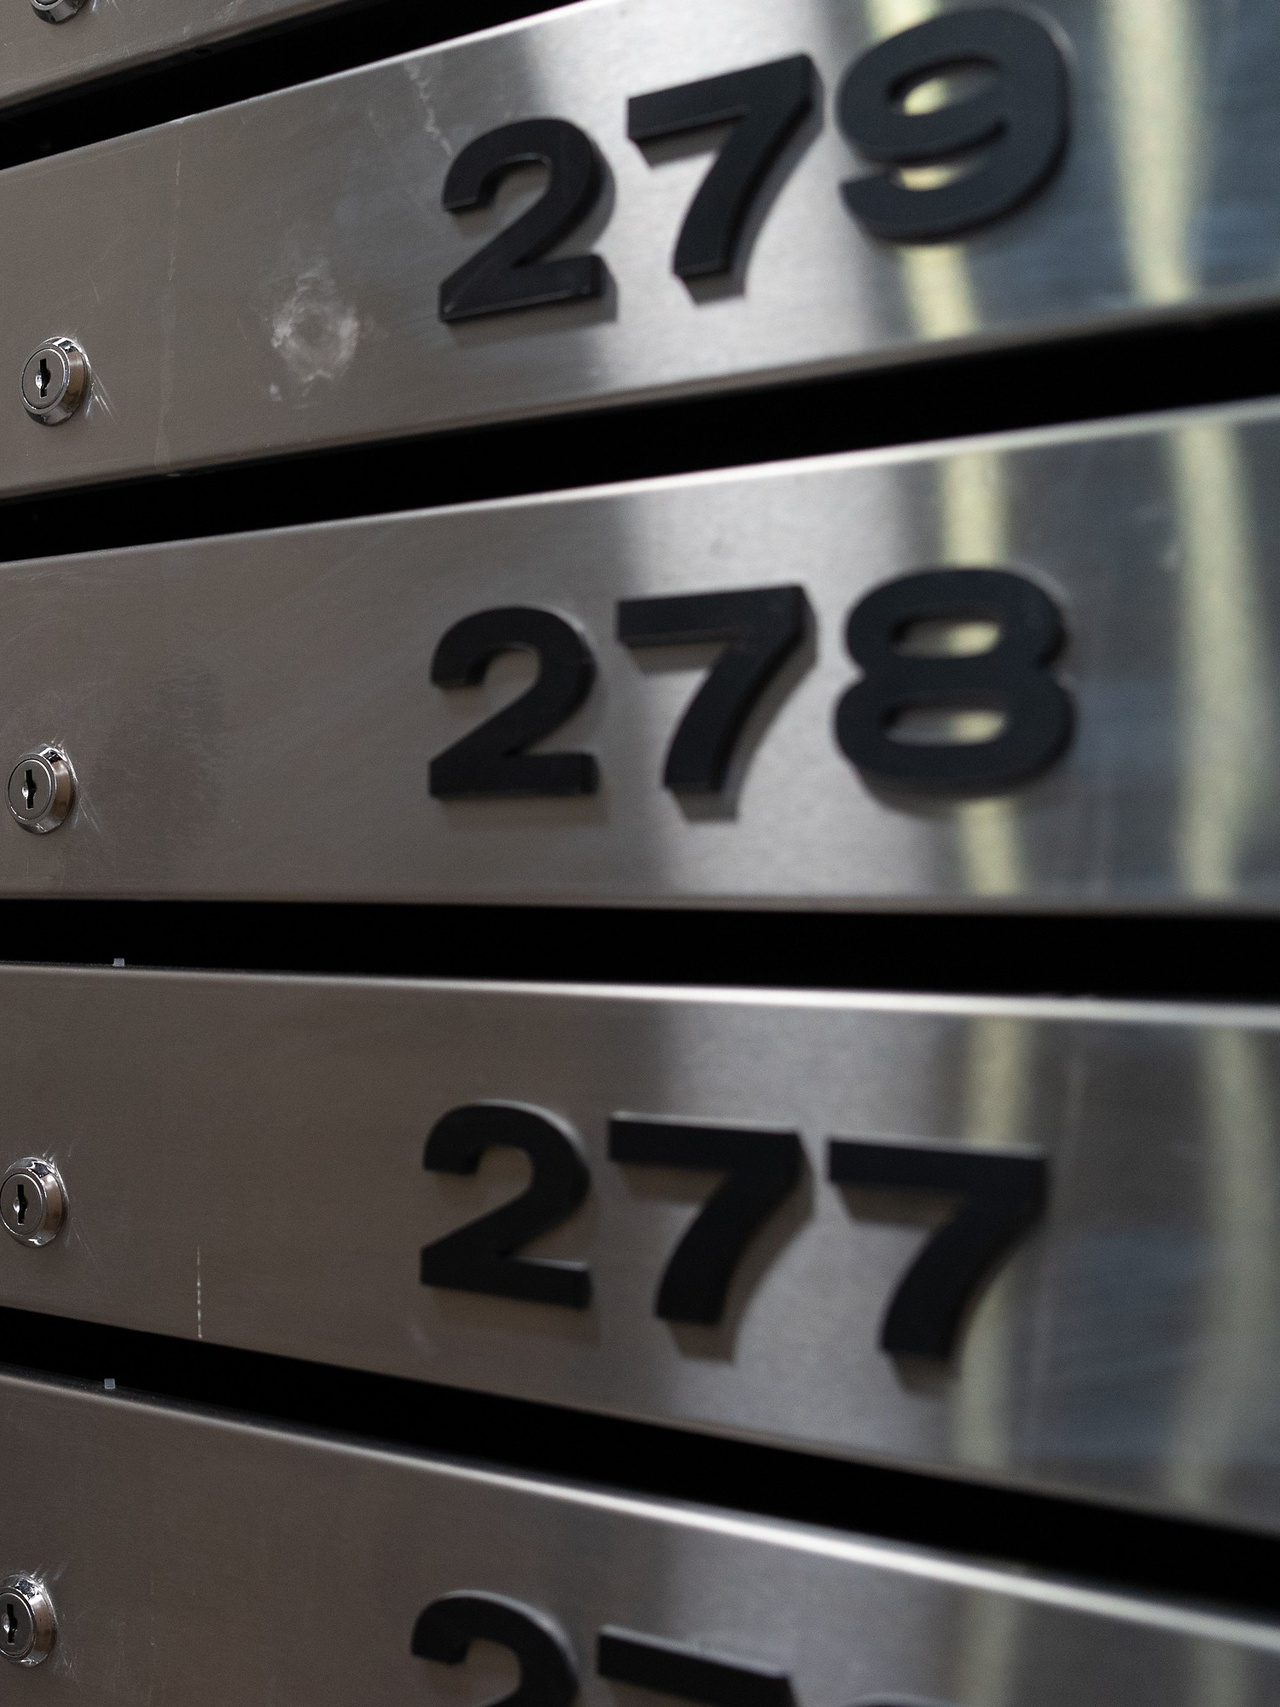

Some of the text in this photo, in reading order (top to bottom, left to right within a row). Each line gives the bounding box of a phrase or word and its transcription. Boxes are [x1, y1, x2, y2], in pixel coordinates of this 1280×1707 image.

[438, 5, 1072, 323] 279
[428, 567, 1074, 797] 278
[420, 1098, 1048, 1362] 277
